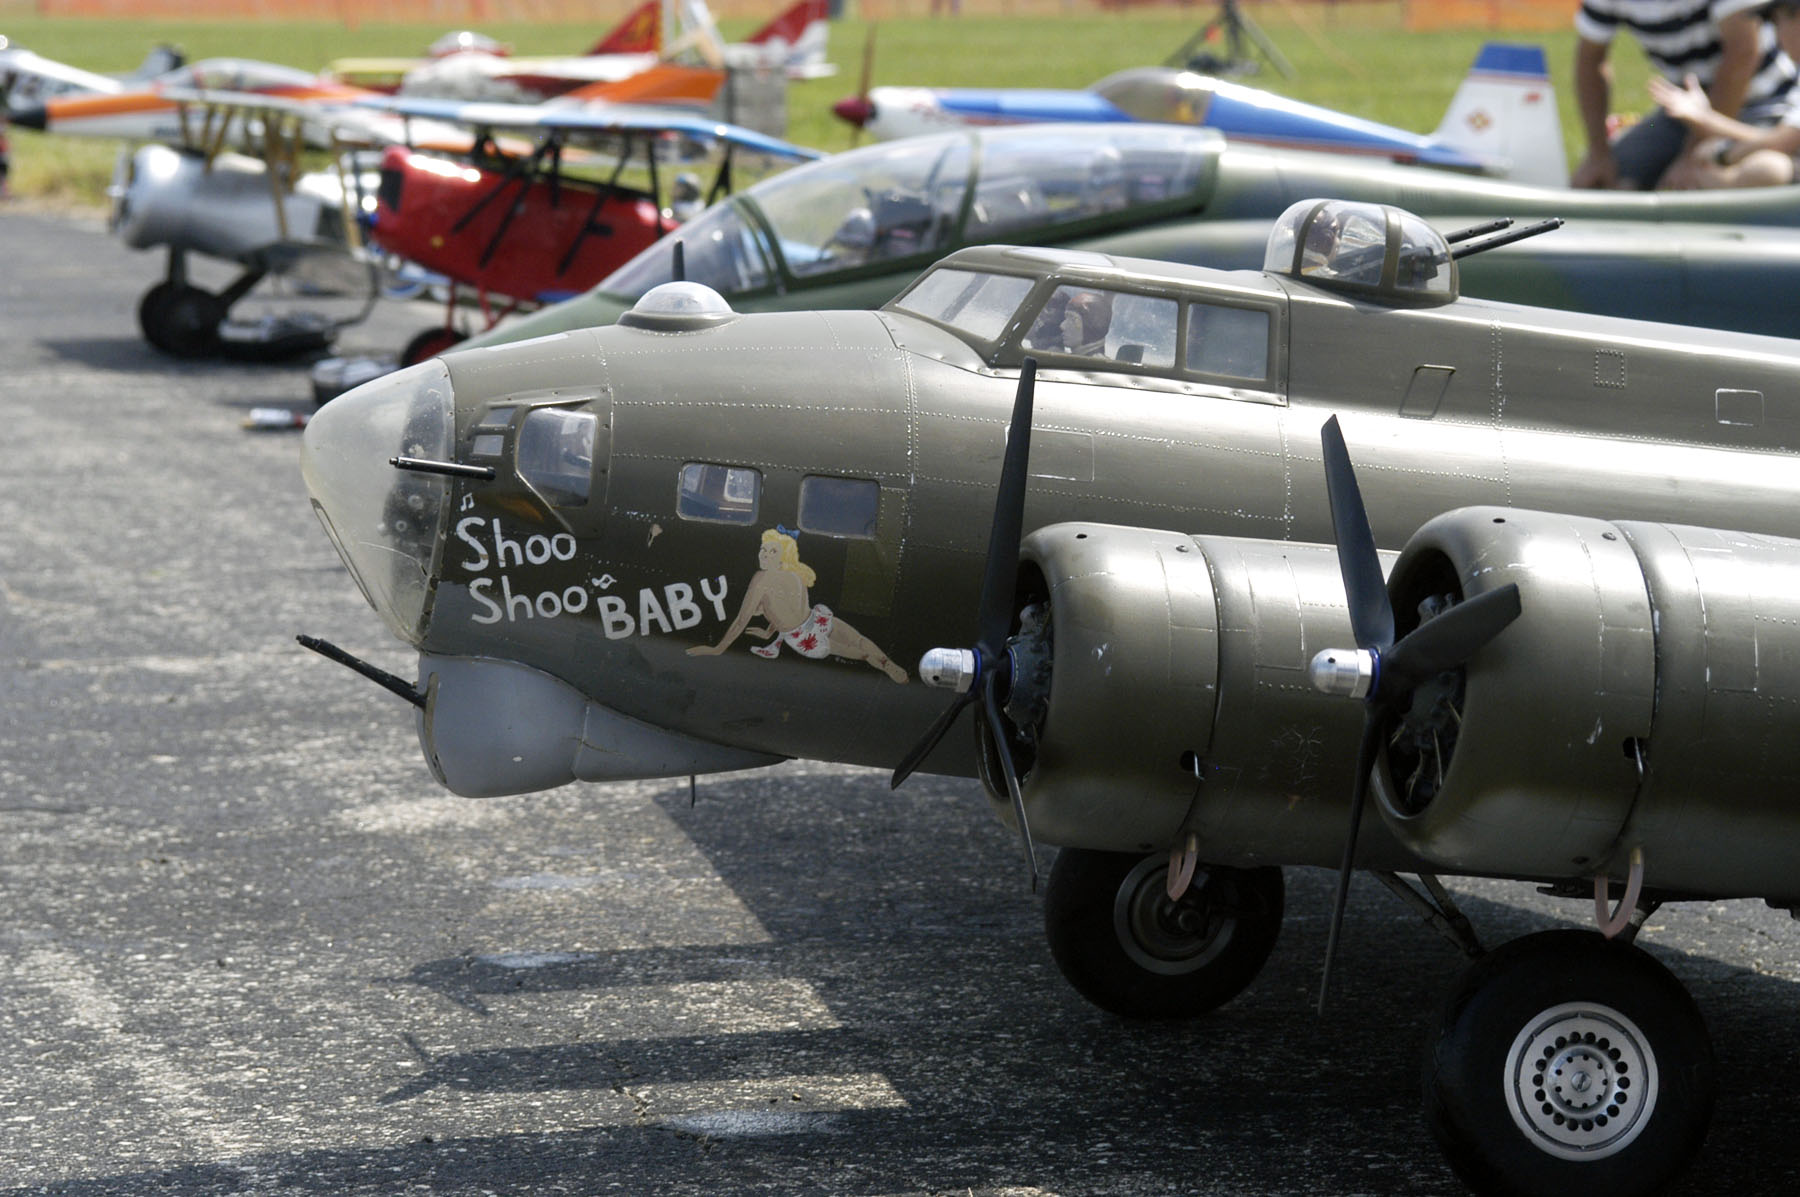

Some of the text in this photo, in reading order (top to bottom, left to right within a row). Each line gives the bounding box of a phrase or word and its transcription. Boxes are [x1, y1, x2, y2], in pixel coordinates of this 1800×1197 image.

[456, 516, 577, 572] Shoo
[469, 575, 729, 640] Shoo BABY
